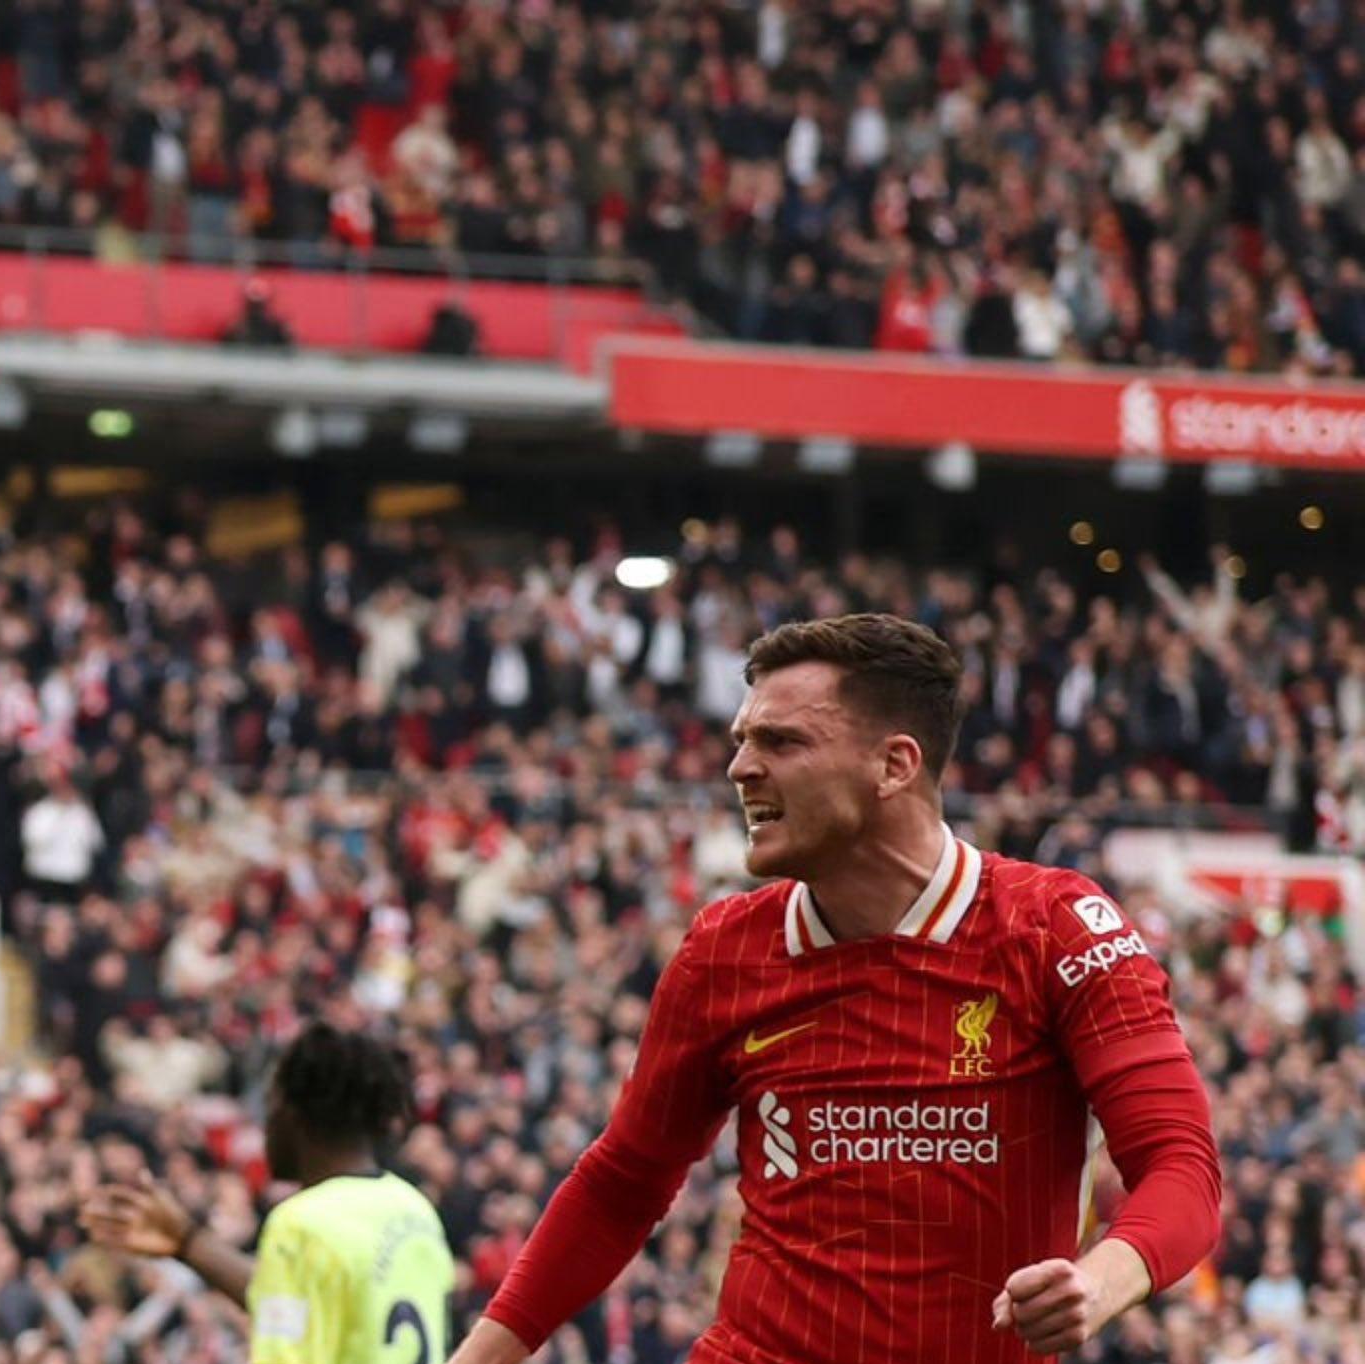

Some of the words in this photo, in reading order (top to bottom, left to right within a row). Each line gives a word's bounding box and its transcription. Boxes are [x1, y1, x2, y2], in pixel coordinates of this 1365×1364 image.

[949, 1058, 996, 1077] LFC
[808, 1101, 989, 1131] standard
[810, 1132, 998, 1163] chartered
